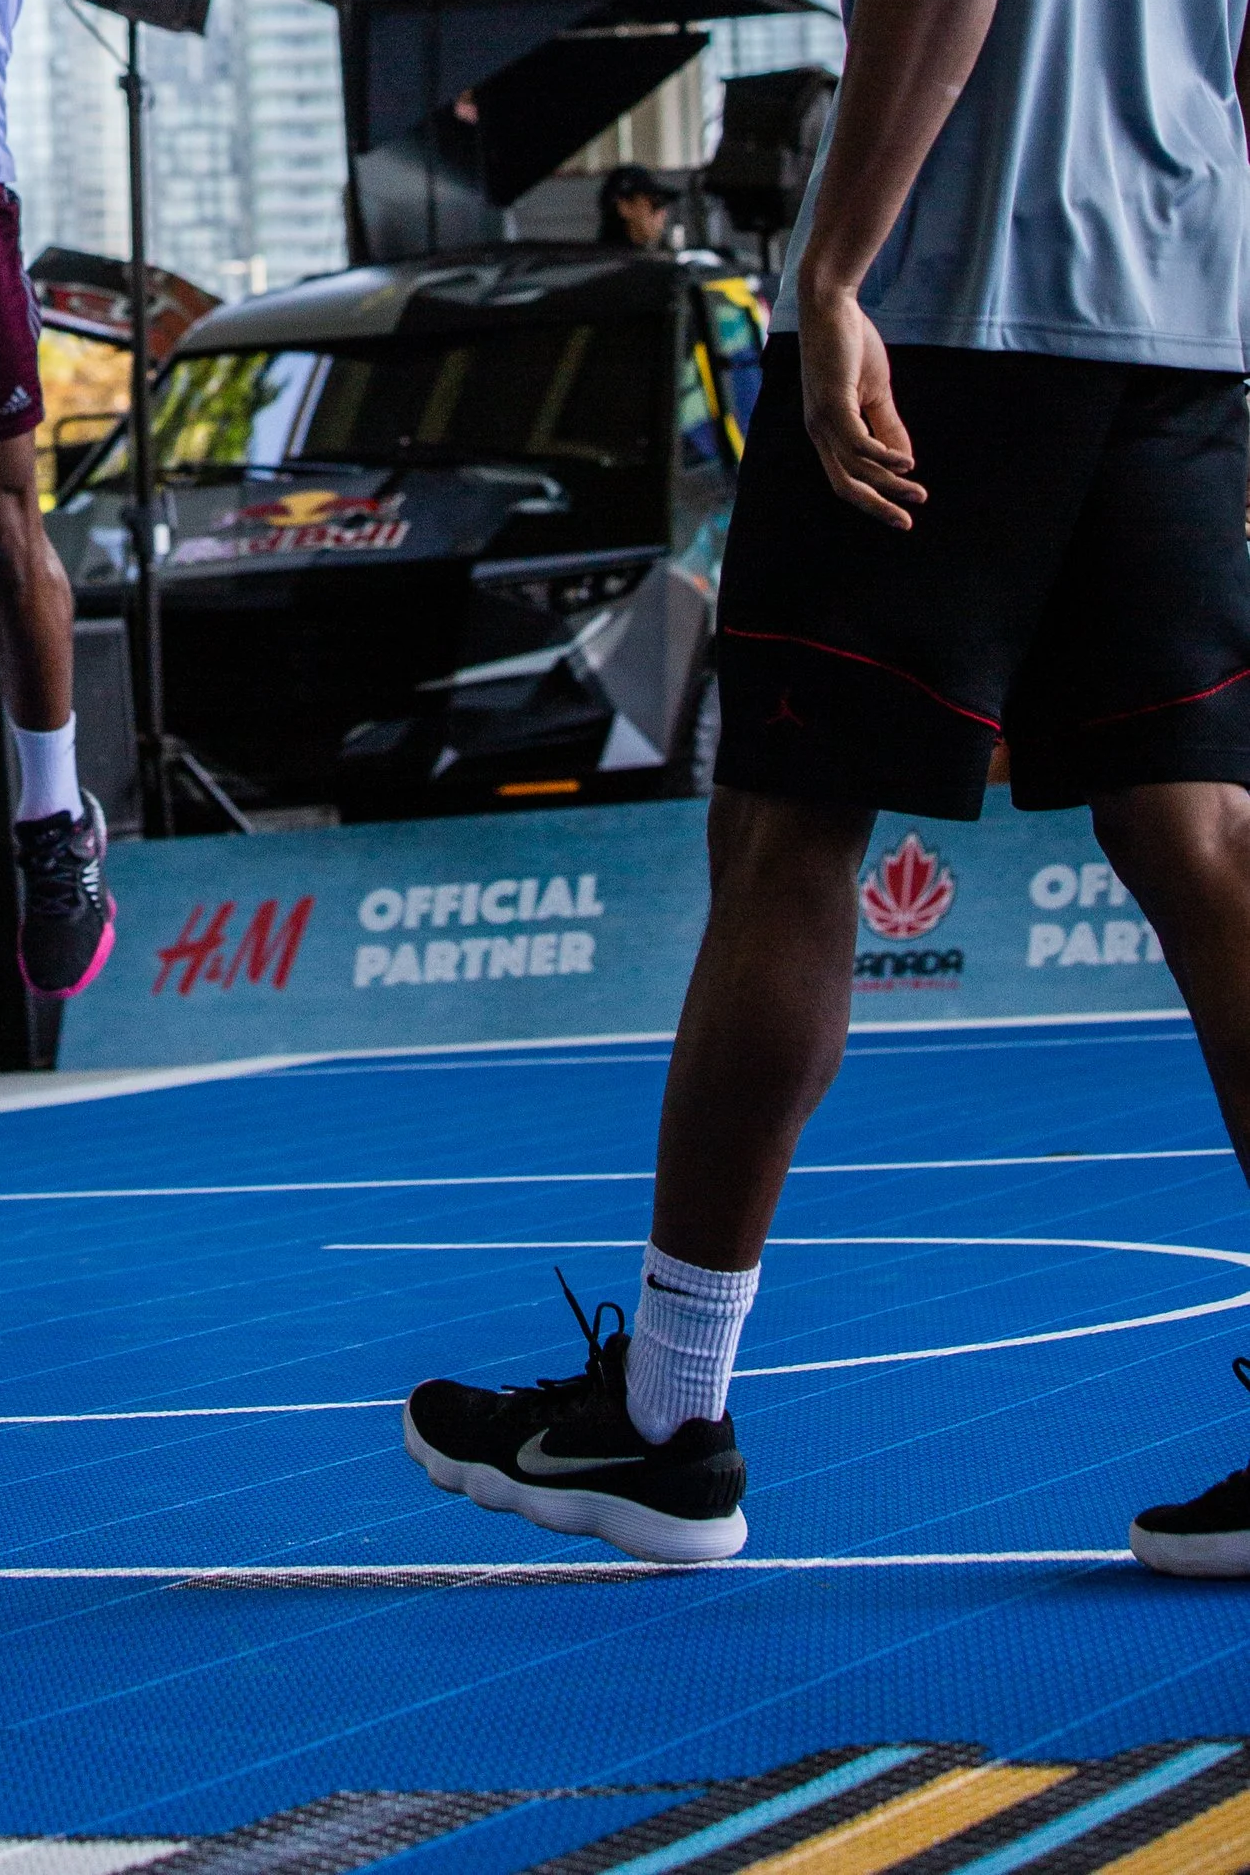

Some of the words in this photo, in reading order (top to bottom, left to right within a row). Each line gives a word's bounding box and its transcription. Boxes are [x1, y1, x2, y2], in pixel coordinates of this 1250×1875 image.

[358, 874, 604, 932] OFFICIAL
[152, 894, 317, 998] H&M
[353, 931, 596, 988] PARTNER
[854, 947, 966, 980] ANADA
